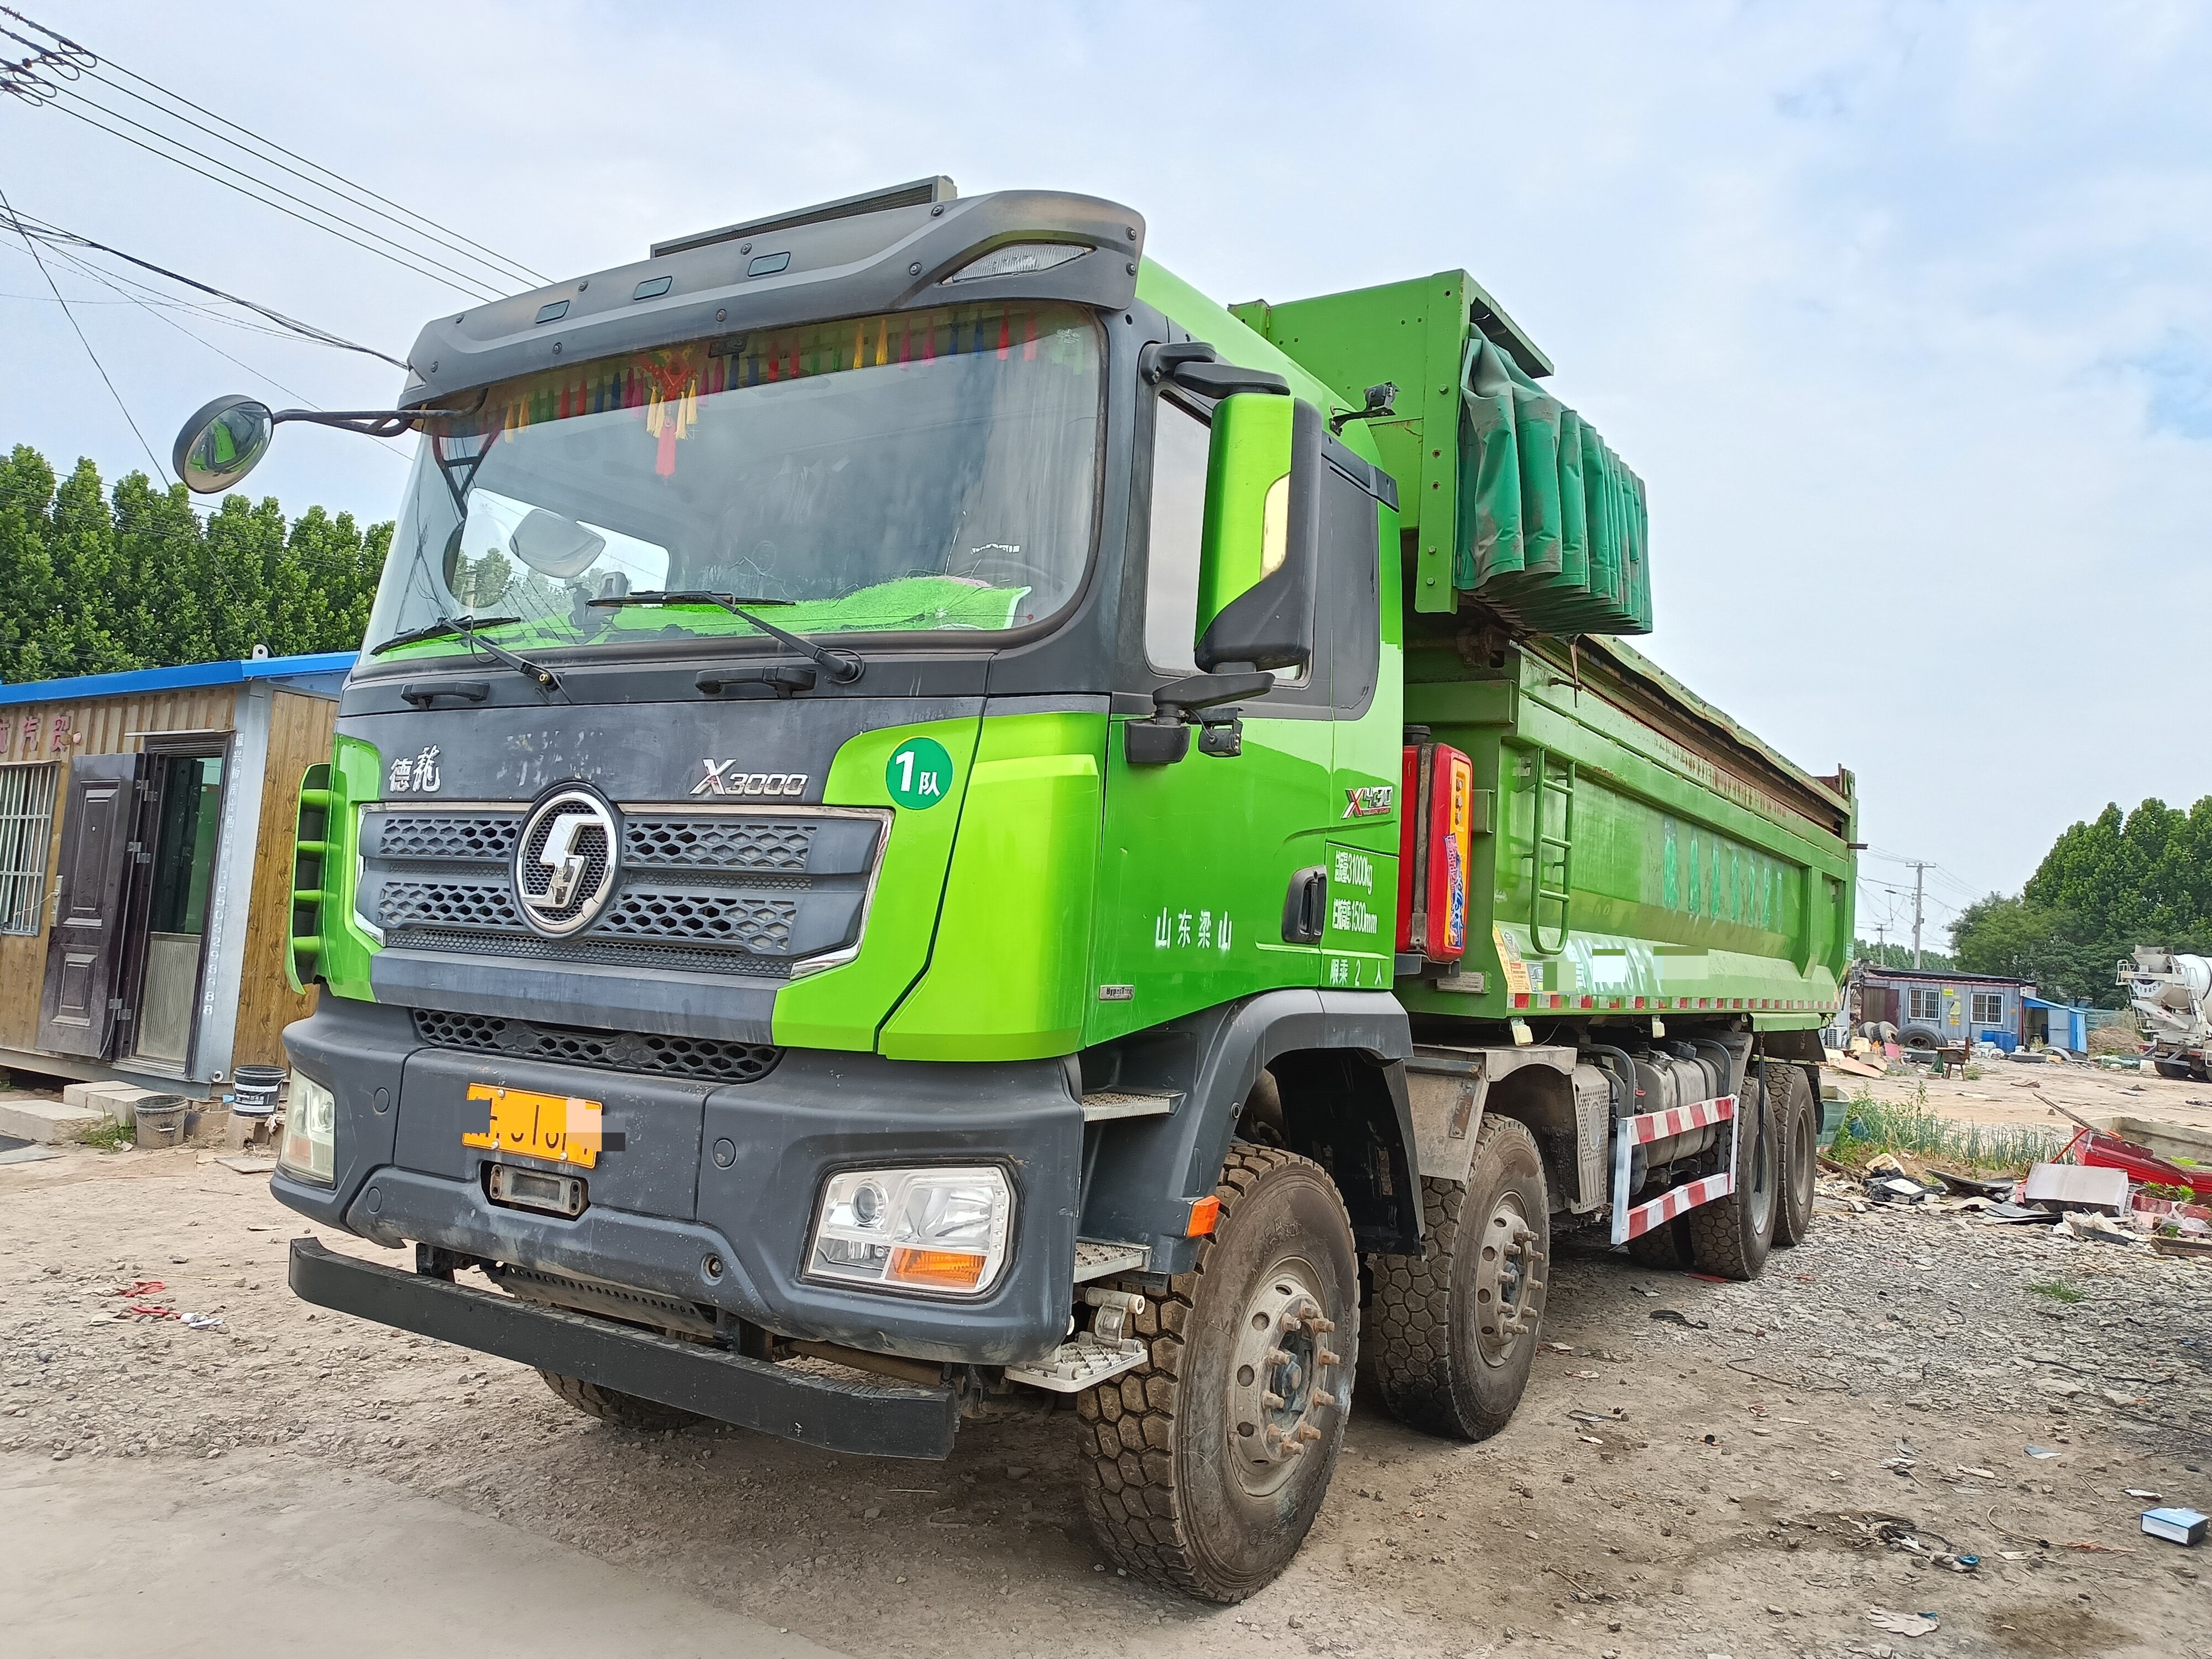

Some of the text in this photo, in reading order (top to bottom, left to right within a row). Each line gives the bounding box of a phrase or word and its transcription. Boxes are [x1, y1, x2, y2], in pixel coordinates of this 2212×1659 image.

[689, 758, 809, 795] X3000
[895, 750, 941, 797] 1队
[1155, 906, 1233, 951] 山东梁山
